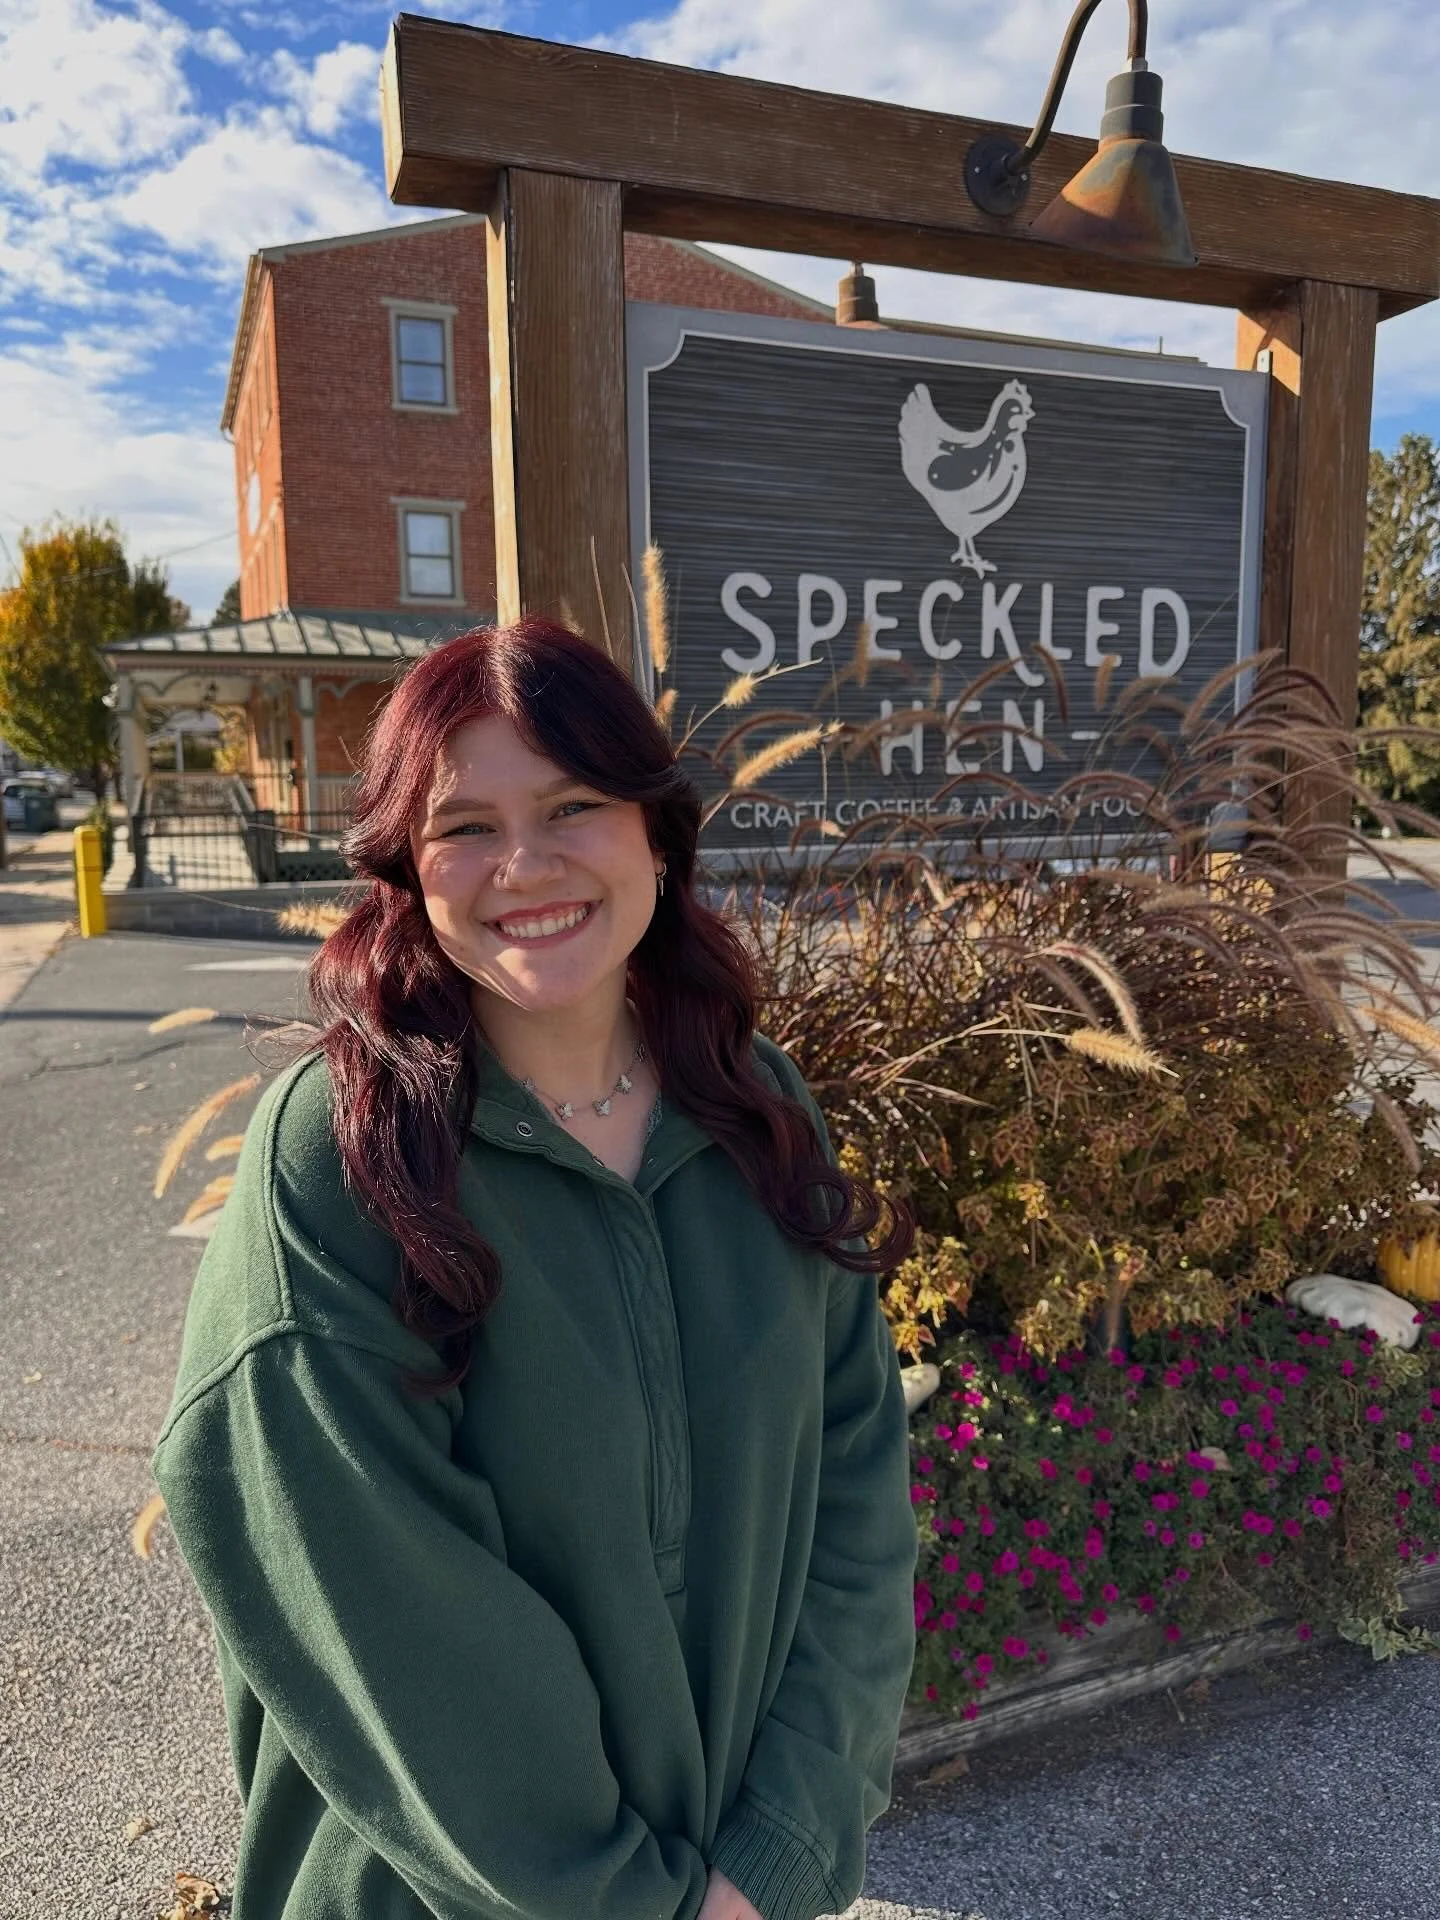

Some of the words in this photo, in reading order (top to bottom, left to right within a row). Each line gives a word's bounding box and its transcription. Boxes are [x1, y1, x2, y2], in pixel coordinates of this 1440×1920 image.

[720, 572, 1191, 687] SPECKLED
[879, 698, 1045, 776] HEN
[729, 801, 826, 829] CRAFT
